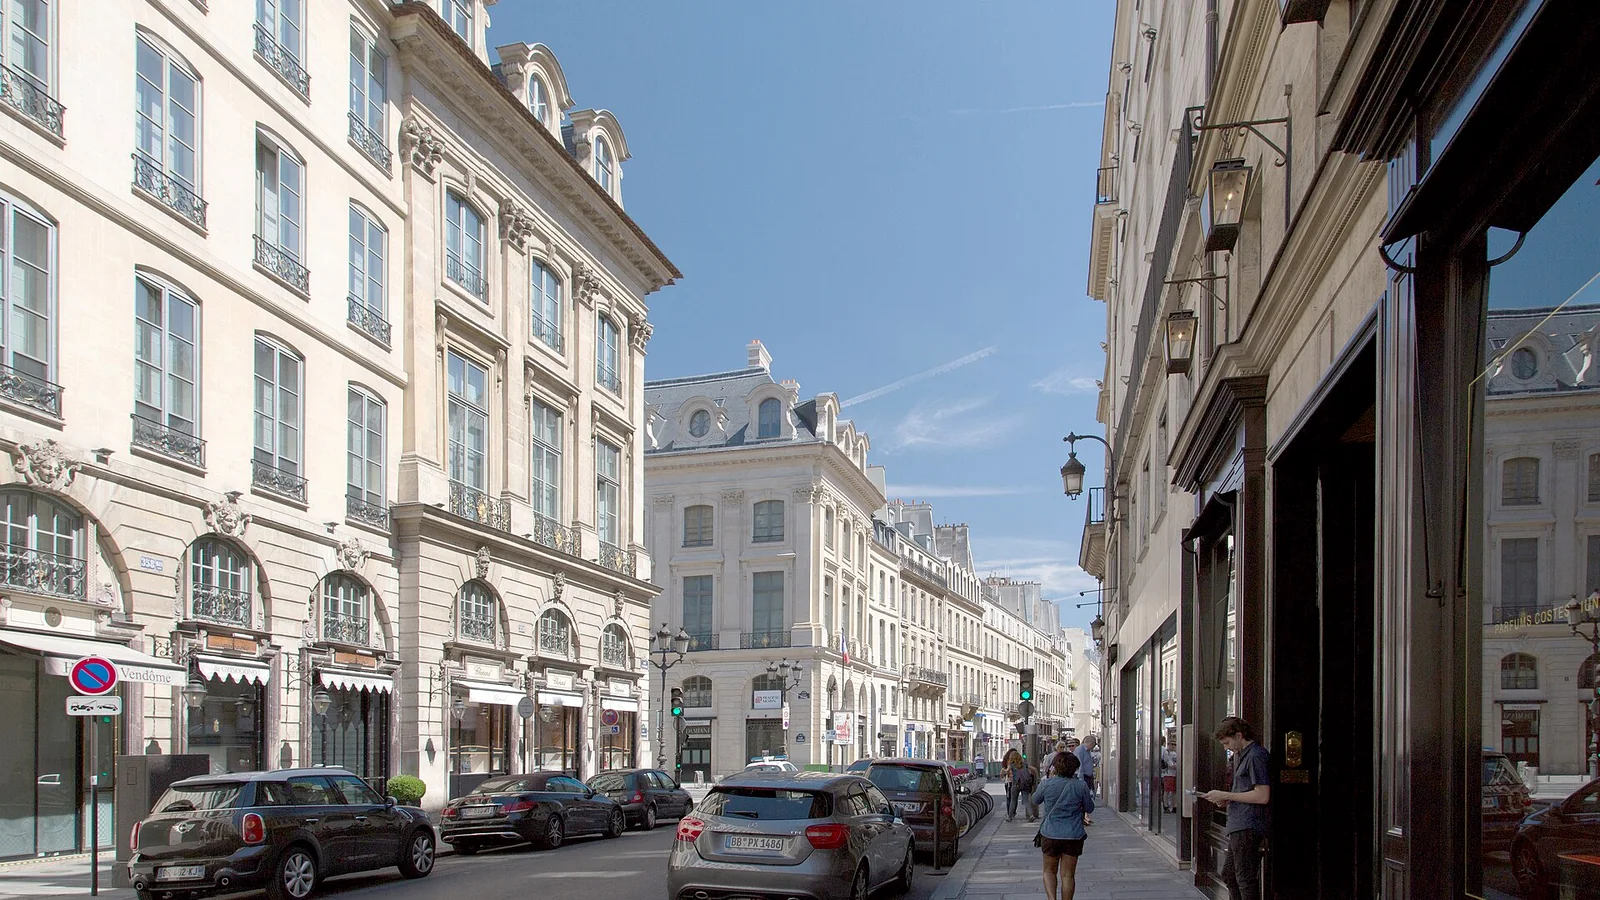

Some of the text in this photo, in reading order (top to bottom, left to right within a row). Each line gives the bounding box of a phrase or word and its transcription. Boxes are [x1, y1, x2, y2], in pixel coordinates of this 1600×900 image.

[1494, 615, 1532, 635] PARFUMS
[1535, 604, 1570, 625] COSTES
[121, 667, 173, 684] Vendôme
[731, 835, 781, 849] BB PX 1486
